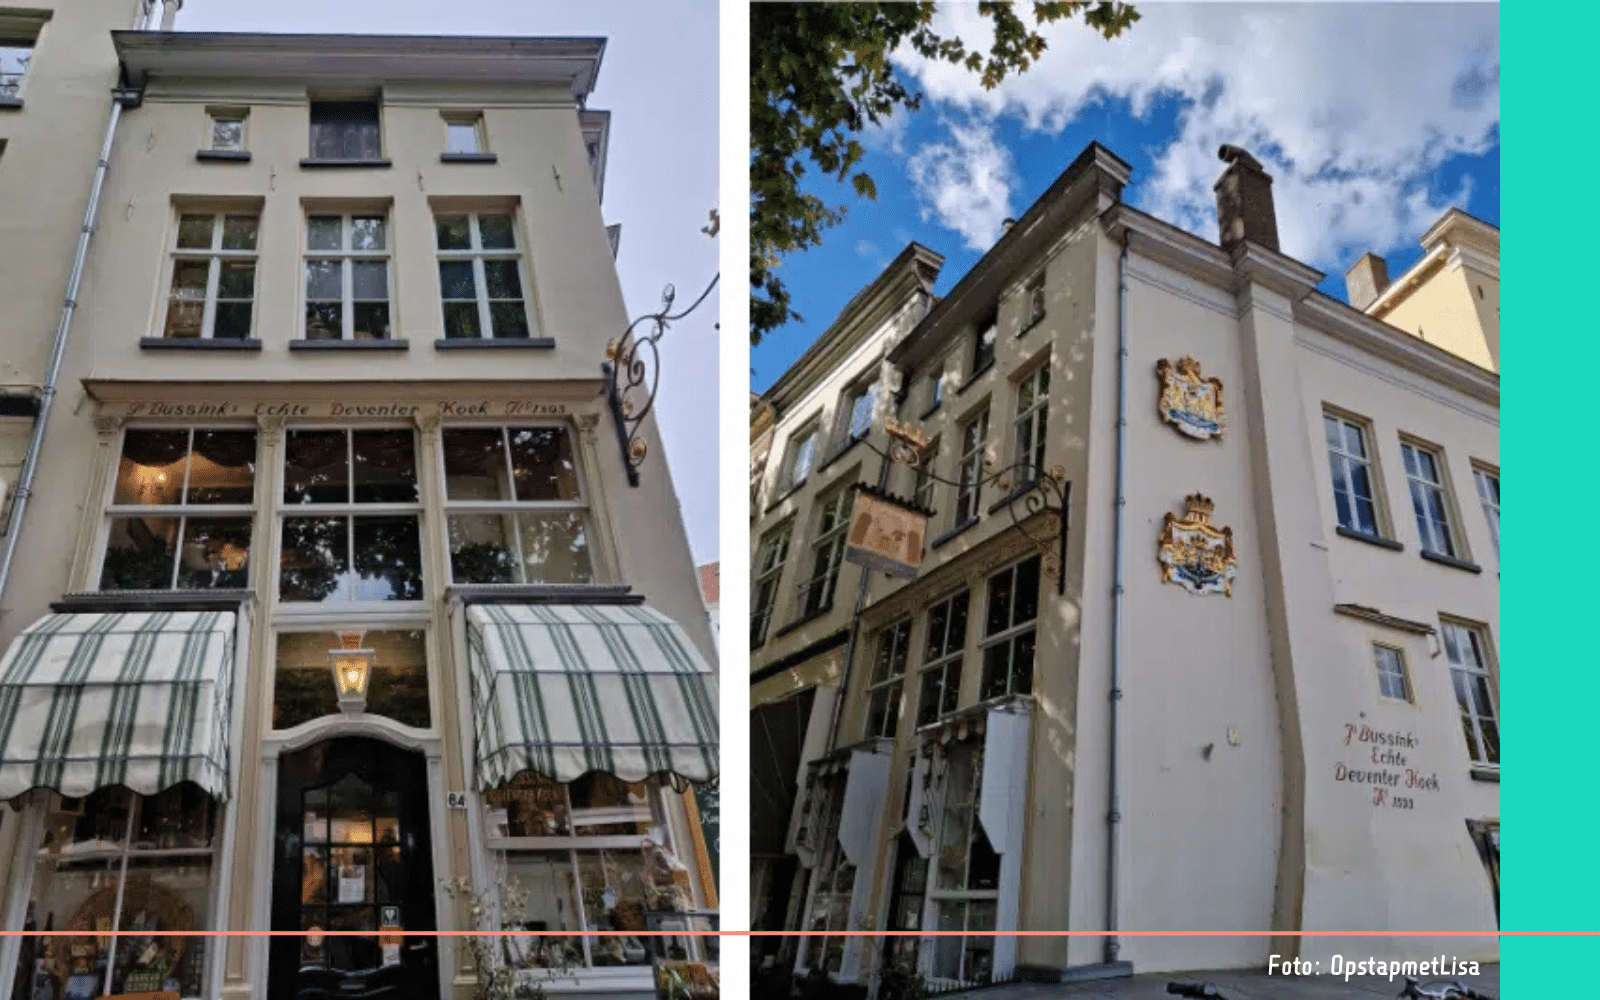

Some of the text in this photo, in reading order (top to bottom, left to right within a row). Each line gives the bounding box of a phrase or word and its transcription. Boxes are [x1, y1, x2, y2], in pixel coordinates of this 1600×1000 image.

[254, 401, 309, 415] Echte
[330, 401, 420, 415] Deventer
[437, 401, 488, 415] Koek
[1371, 746, 1407, 766] Echte
[1334, 761, 1440, 792] Deventer Koek
